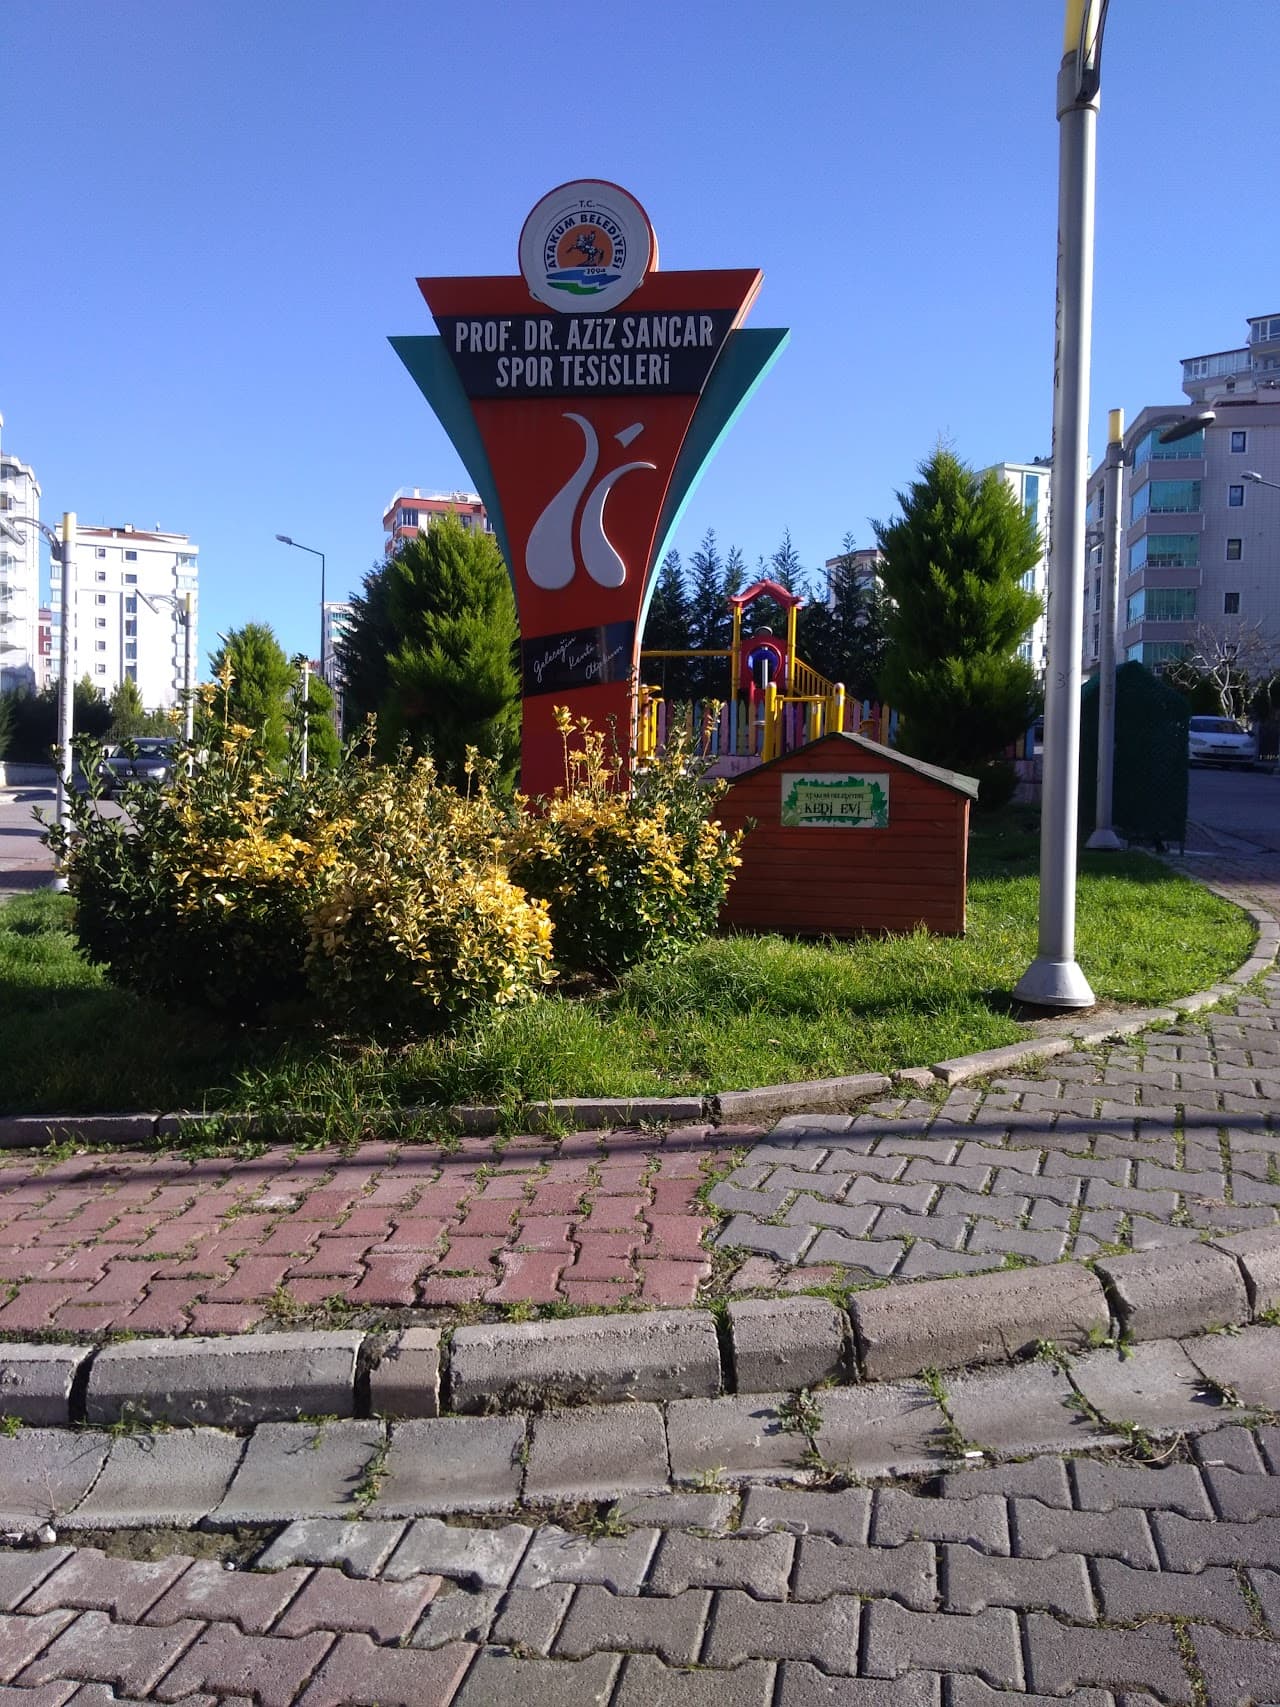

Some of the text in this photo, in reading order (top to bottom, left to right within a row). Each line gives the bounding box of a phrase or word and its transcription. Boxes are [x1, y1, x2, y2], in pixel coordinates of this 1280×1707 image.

[579, 199, 596, 208] T.C.
[547, 217, 576, 269] ATAKUM
[455, 320, 517, 352] PROF.
[524, 319, 560, 350] DR.
[622, 316, 714, 348] SANCAR
[496, 356, 553, 388] SPOR
